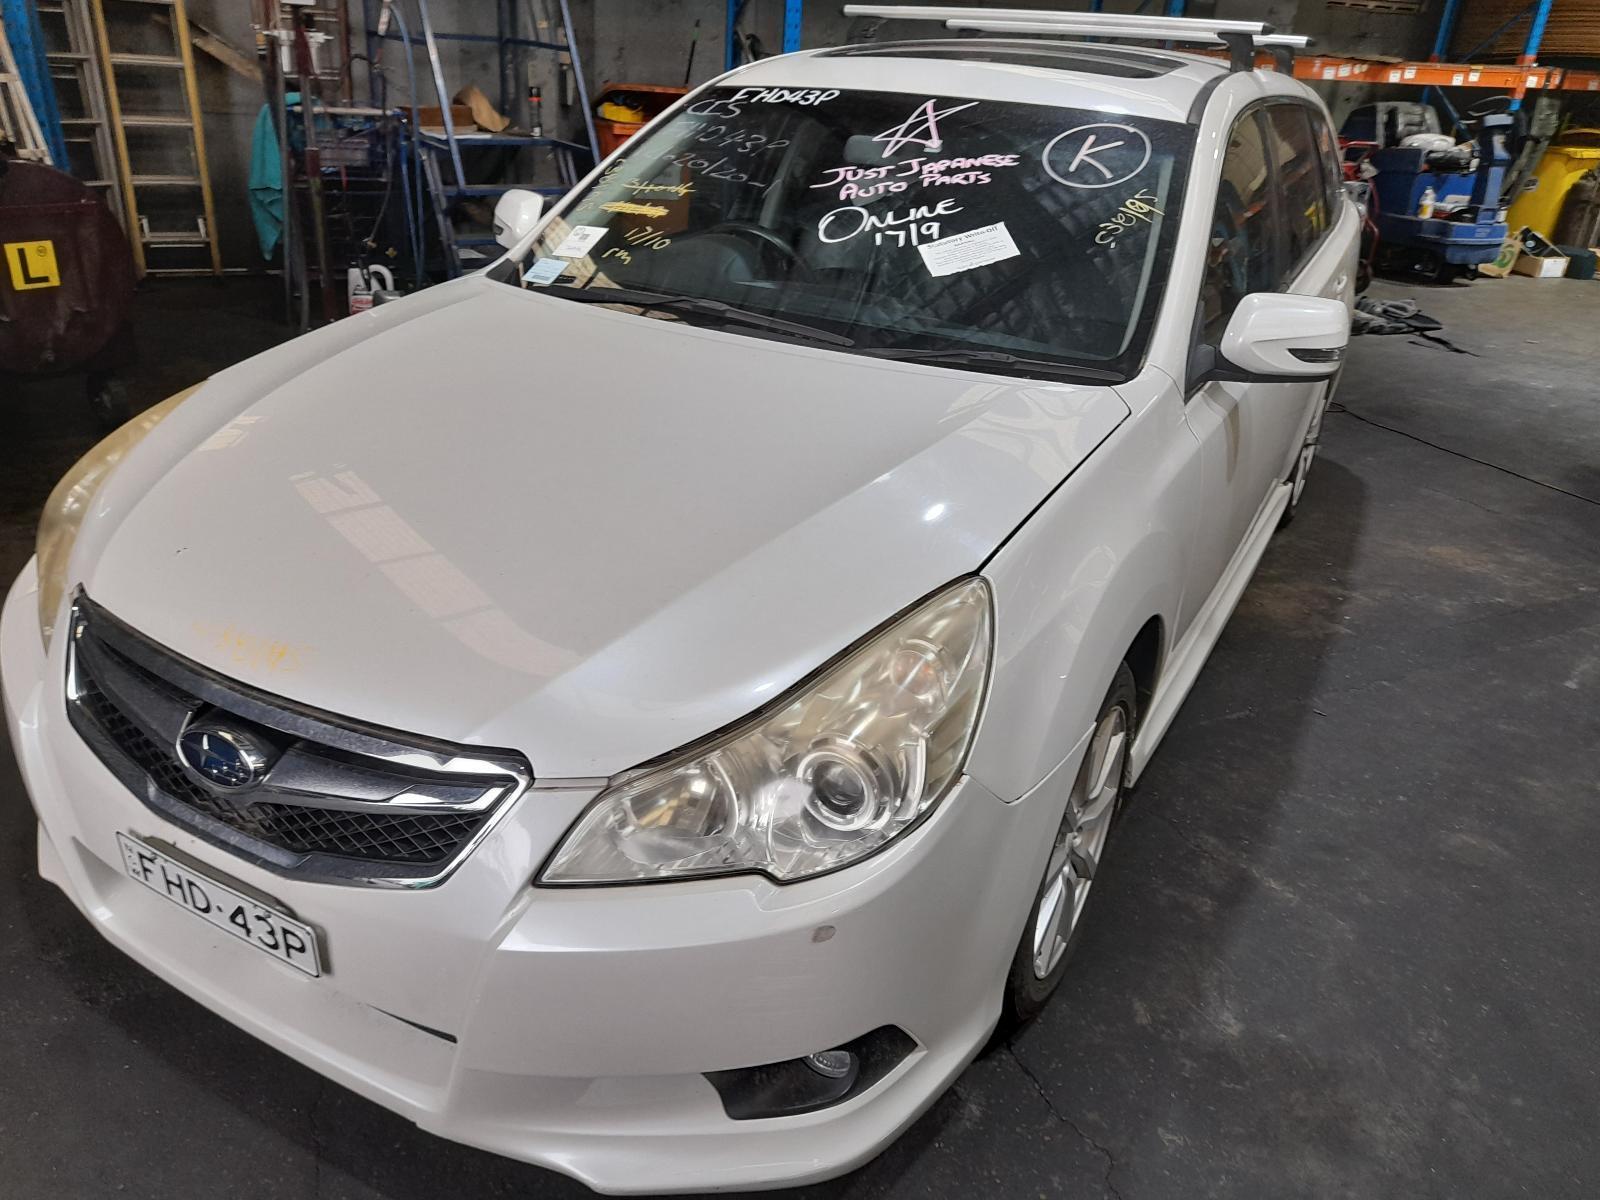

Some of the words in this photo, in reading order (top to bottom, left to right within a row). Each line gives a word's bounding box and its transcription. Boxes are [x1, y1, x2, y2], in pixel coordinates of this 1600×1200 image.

[730, 87, 841, 106] FHD43P
[809, 165, 896, 189] JUST
[896, 154, 1020, 178] JAPANESE
[1068, 134, 1124, 179] K
[838, 181, 908, 201] AUTO
[919, 171, 992, 188] PARTS
[17, 247, 50, 285] L
